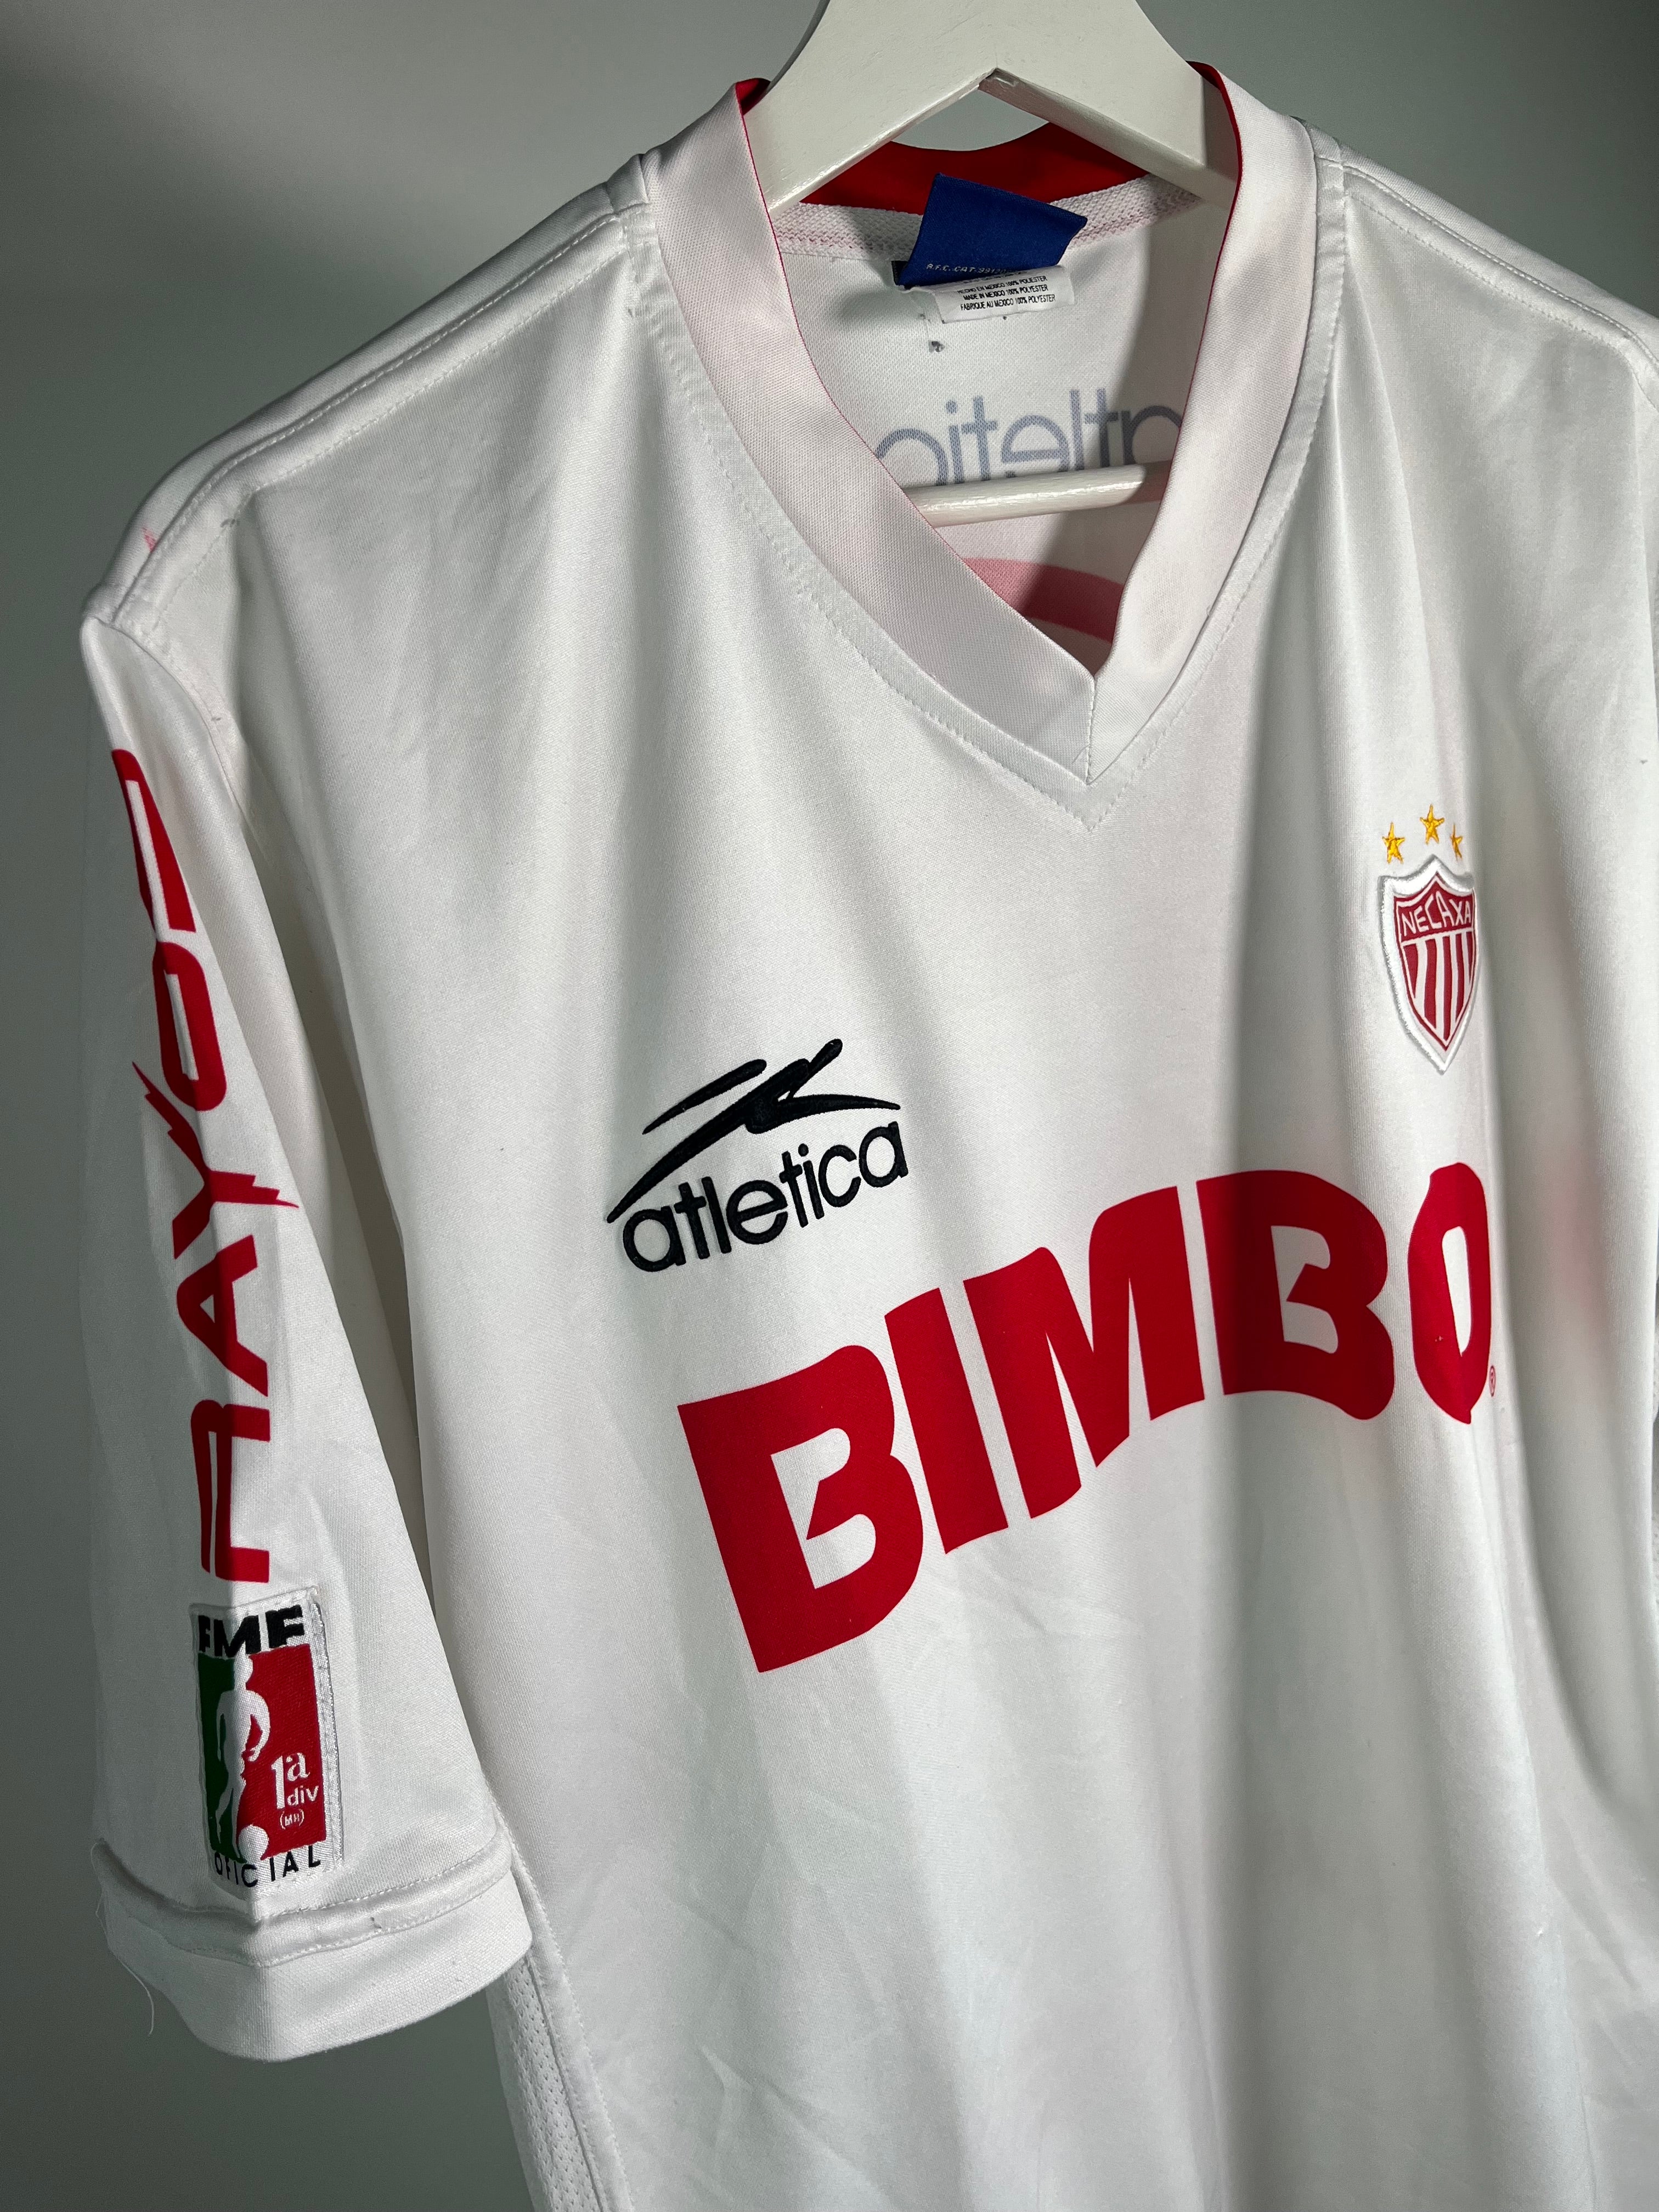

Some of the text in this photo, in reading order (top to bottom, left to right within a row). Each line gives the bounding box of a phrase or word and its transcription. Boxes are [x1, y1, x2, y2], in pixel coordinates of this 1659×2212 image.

[1019, 275, 1048, 284] POLIESTER
[1019, 284, 1049, 294] POLYESTER
[961, 302, 986, 311] FABRIQUE
[994, 298, 1014, 307] MEXICO
[1028, 294, 1056, 304] POLYESTER
[1401, 890, 1472, 937] NECAXA
[623, 1120, 909, 1273] atletica
[677, 1162, 1492, 1673] BIMBO
[198, 1605, 305, 1658] FMF
[287, 1785, 319, 1806] div
[214, 1844, 321, 1888] OFICIAL
